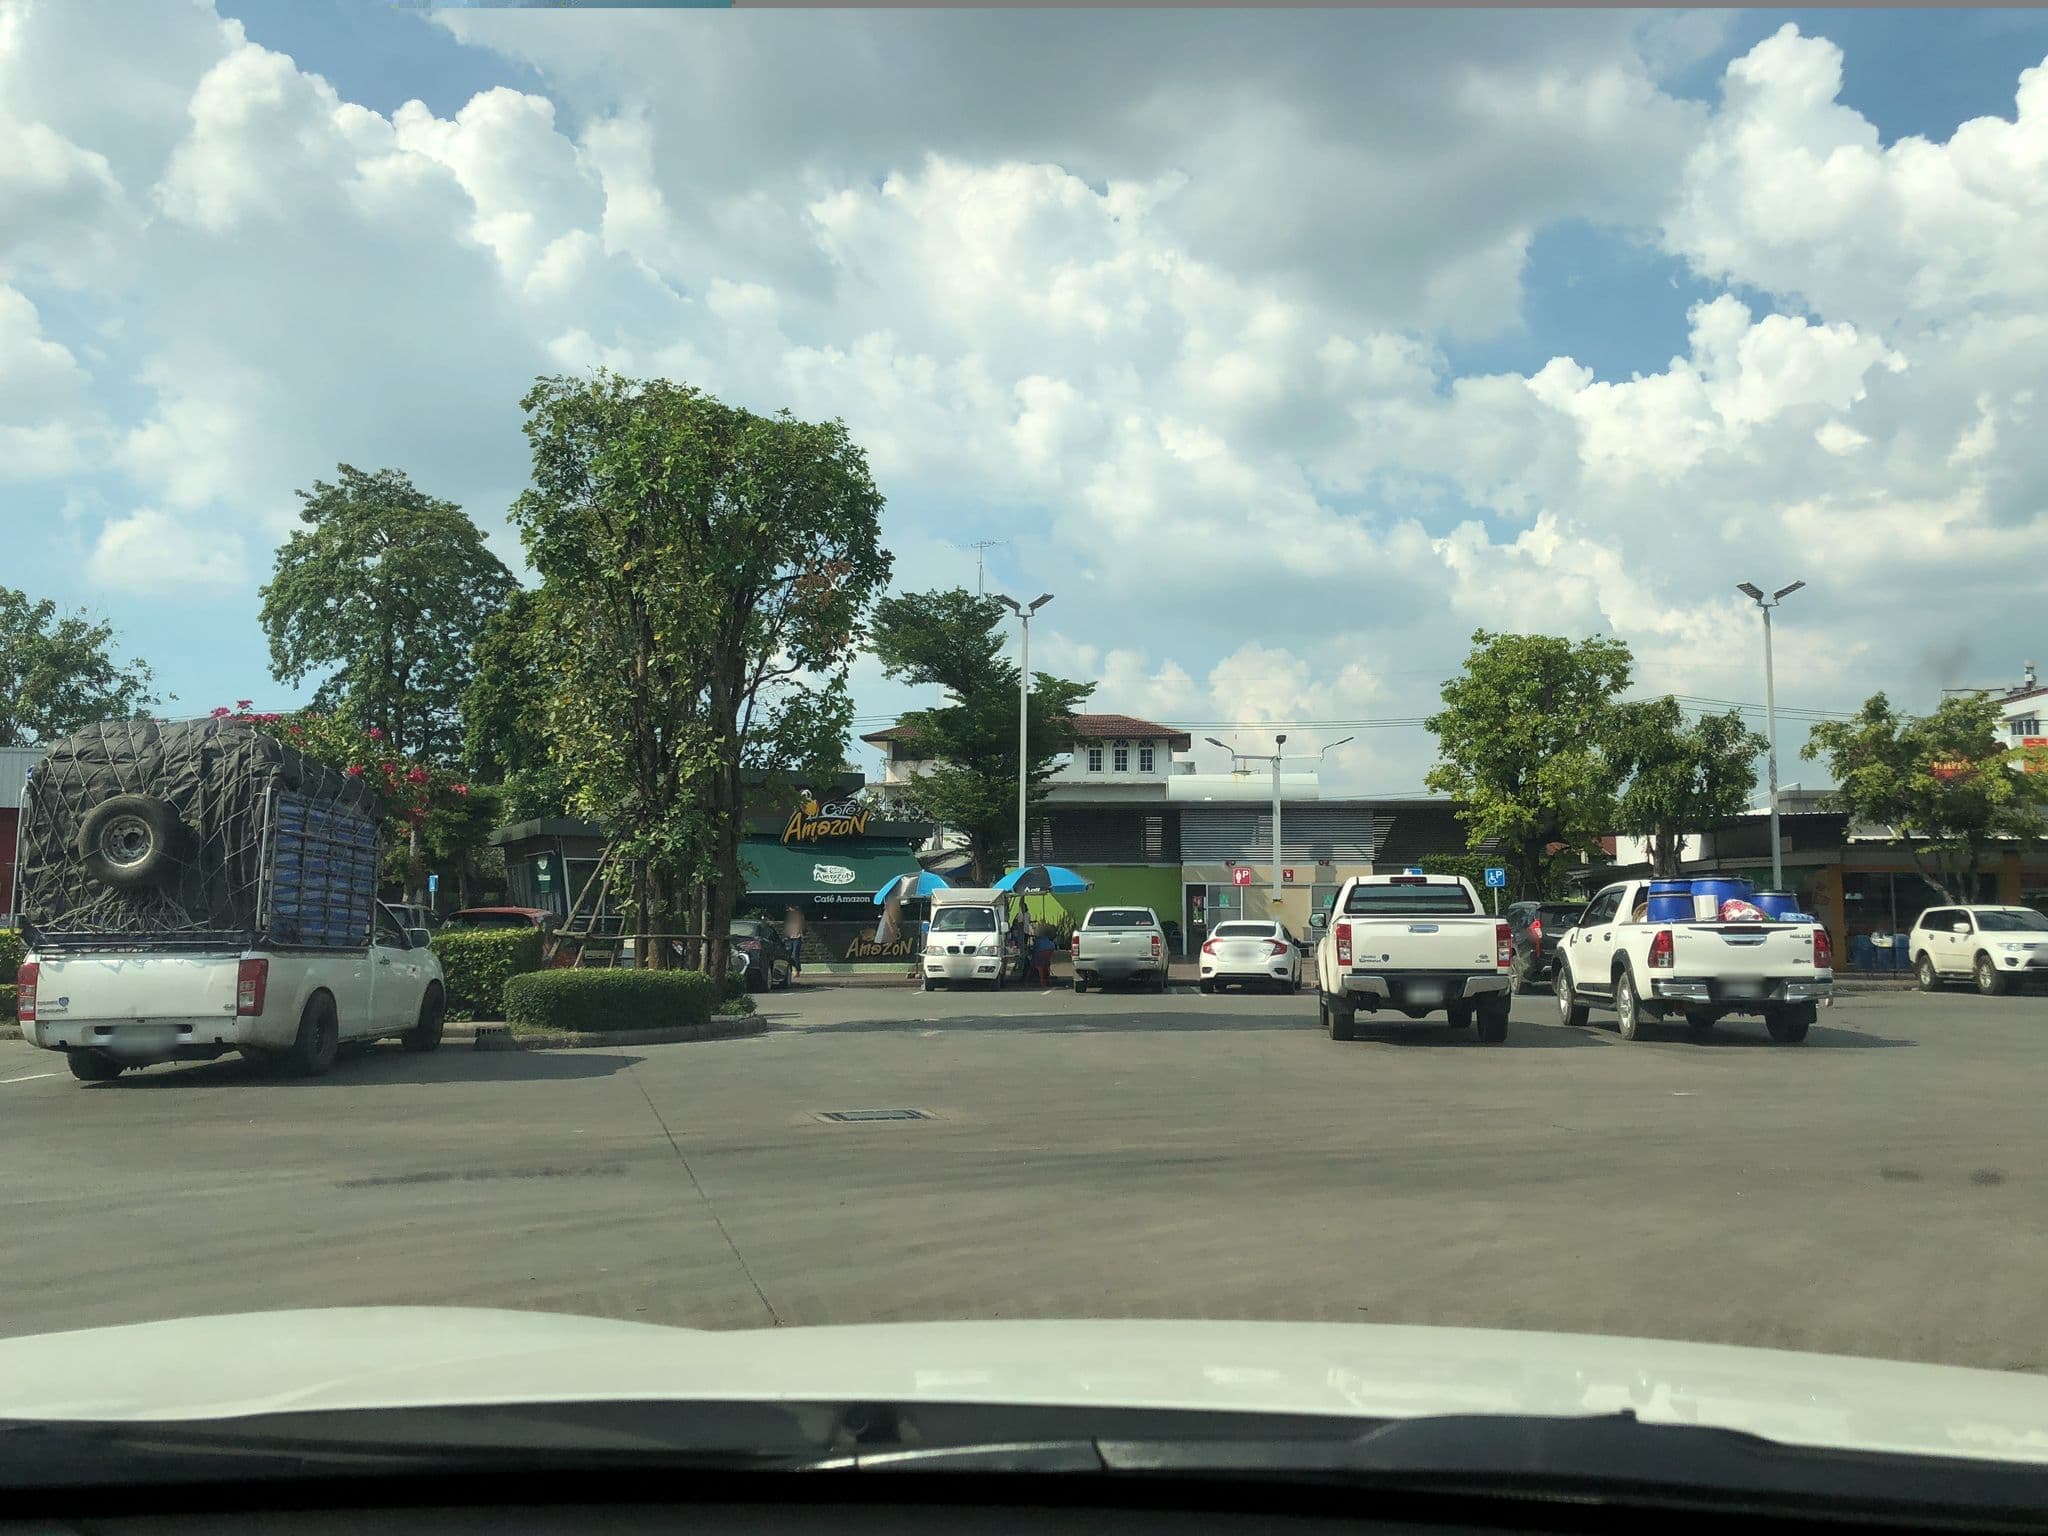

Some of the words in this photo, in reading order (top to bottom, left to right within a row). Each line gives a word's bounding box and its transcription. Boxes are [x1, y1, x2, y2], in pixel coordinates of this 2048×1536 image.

[1242, 870, 1249, 878] P
[1495, 870, 1503, 878] P
[814, 894, 834, 903] Café
[837, 895, 871, 903] Amazon
